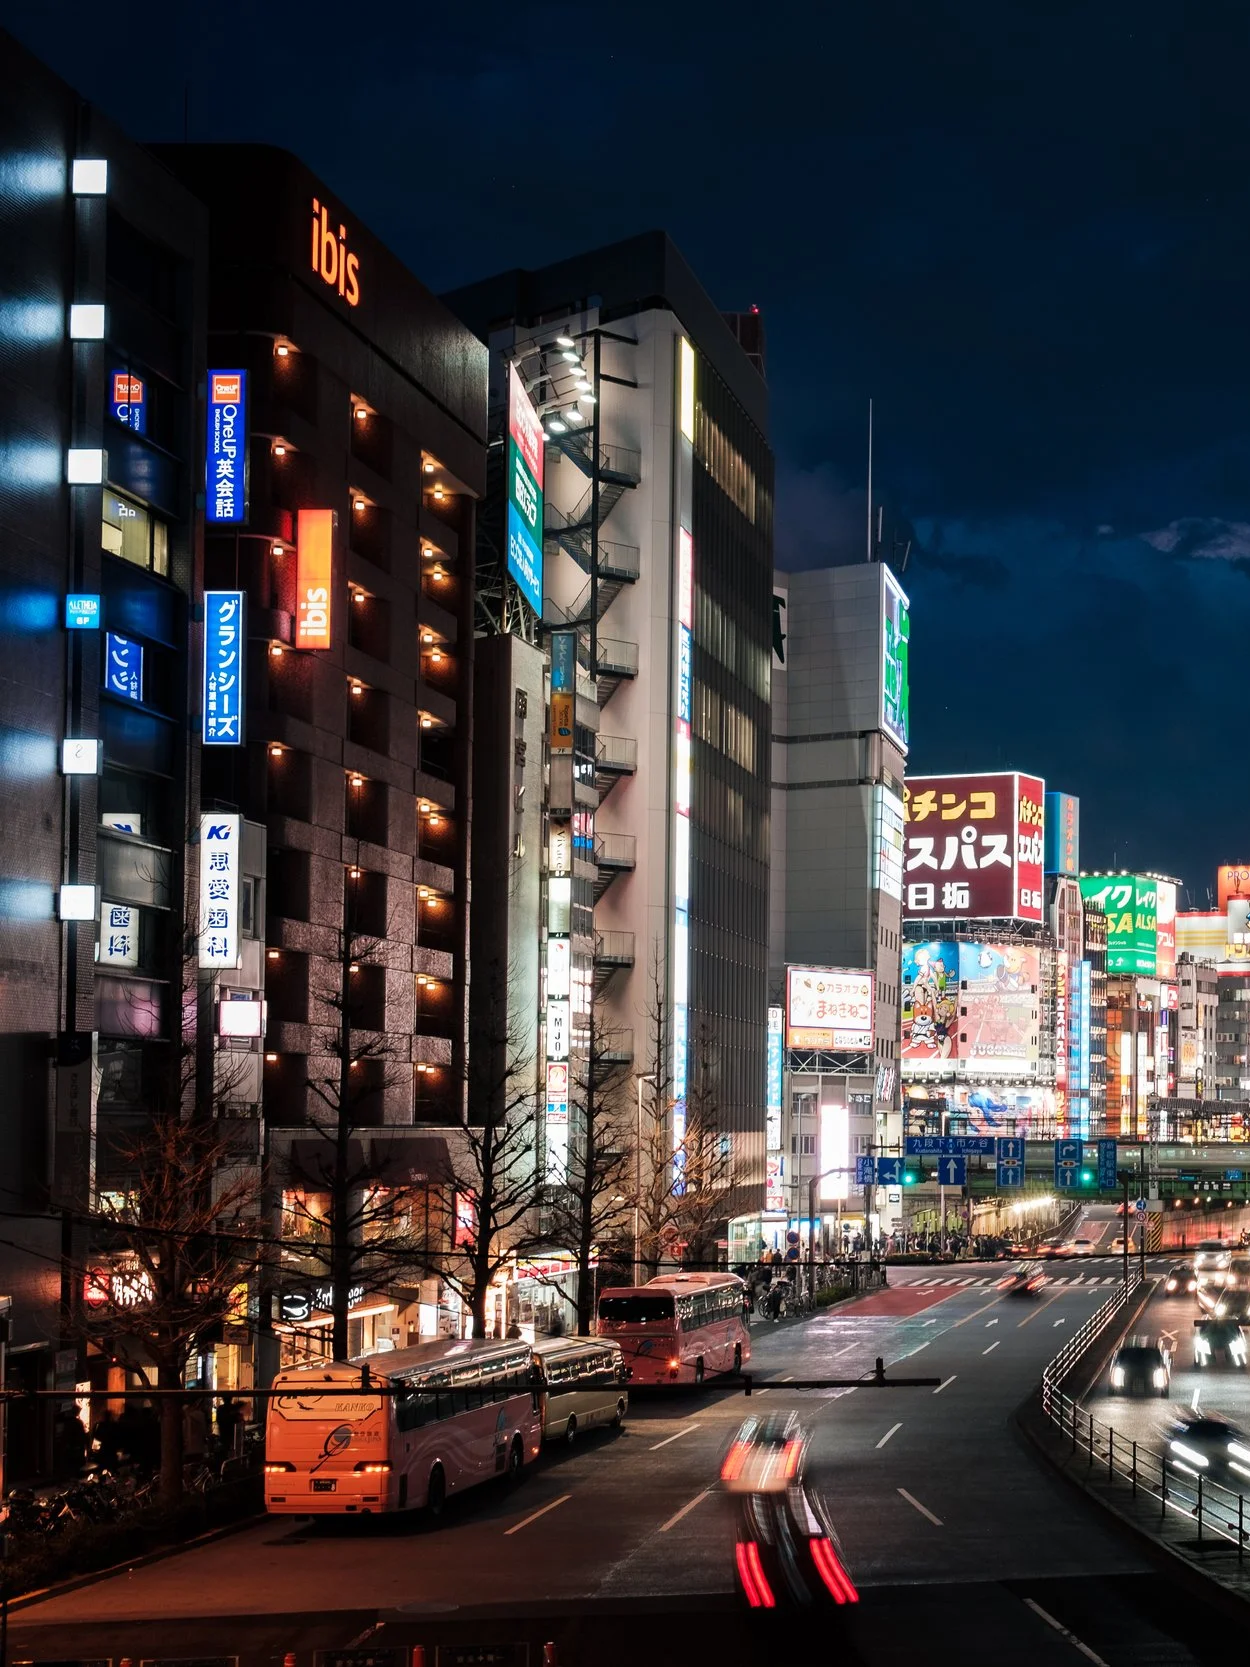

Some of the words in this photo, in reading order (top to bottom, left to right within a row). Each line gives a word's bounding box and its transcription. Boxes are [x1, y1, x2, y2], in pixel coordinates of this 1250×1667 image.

[312, 198, 359, 306] ibis
[216, 458, 235, 518] 英会話
[300, 587, 328, 636] ibis
[217, 599, 239, 737] グランシーズ
[1019, 795, 1043, 827] パチンコ
[908, 882, 970, 911] 日拓
[1135, 912, 1157, 932] ALSA
[1157, 931, 1175, 948] アコム
[816, 1000, 869, 1020] まねきねこ
[912, 1138, 946, 1148] 九段下
